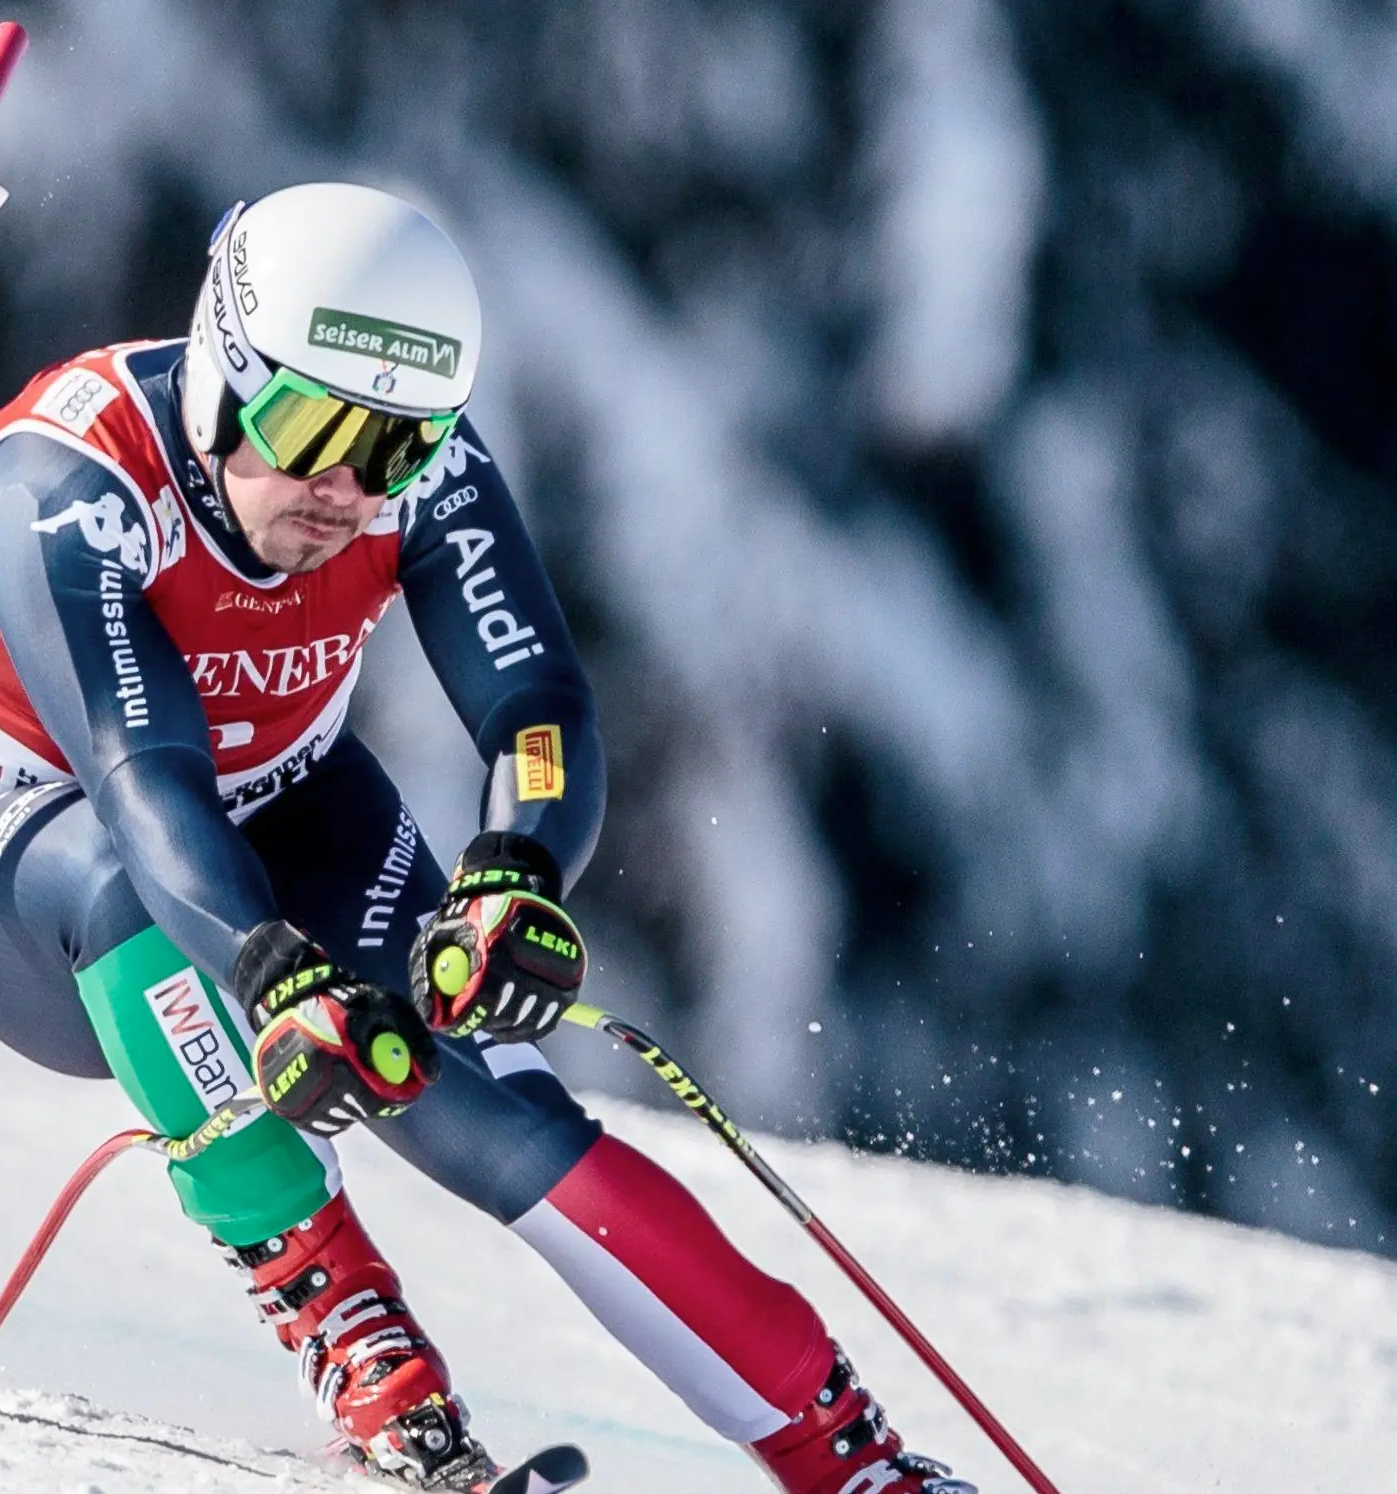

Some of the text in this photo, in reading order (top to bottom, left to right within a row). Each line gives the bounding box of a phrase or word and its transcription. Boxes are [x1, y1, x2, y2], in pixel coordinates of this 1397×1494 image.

[444, 528, 545, 671] Audi
[525, 729, 554, 791] PIRELLI
[525, 925, 579, 960] LEKI
[267, 964, 333, 1010] LEKI
[154, 978, 251, 1131] IWBan
[268, 1052, 309, 1102] LEKI
[638, 1045, 708, 1108] LEKI
